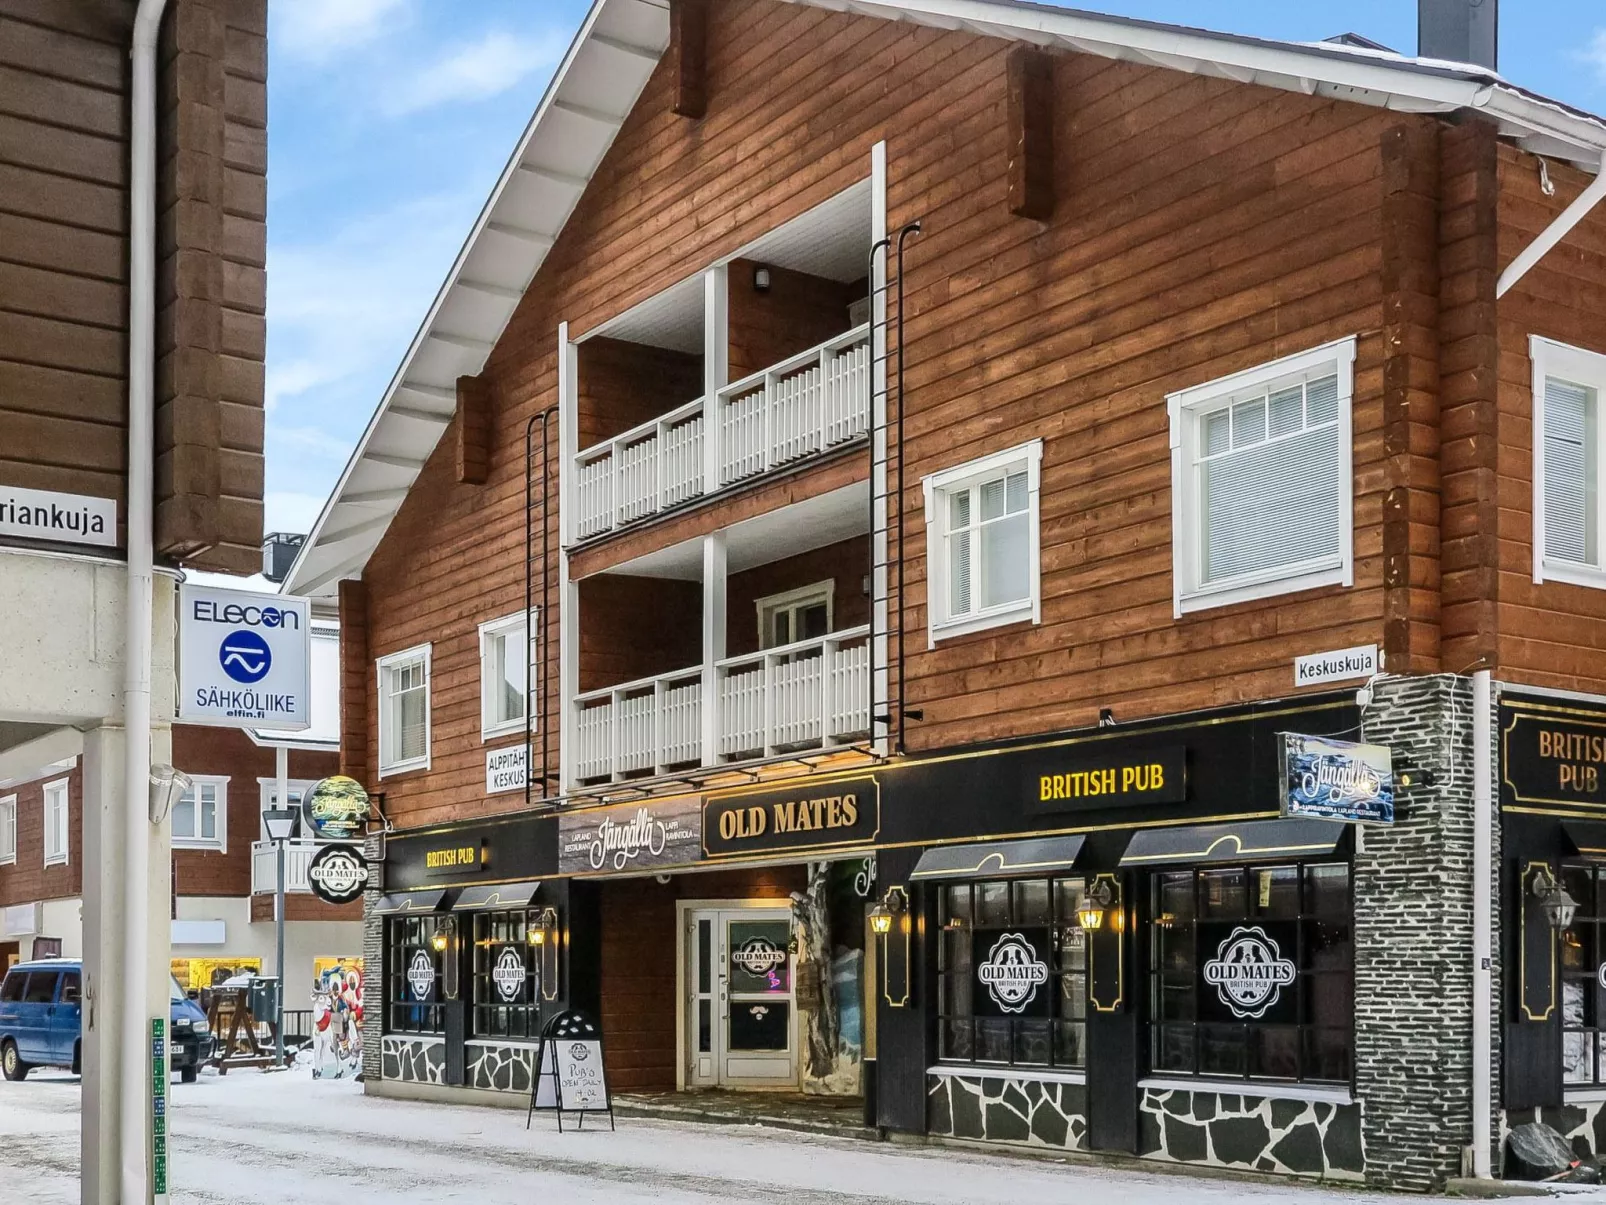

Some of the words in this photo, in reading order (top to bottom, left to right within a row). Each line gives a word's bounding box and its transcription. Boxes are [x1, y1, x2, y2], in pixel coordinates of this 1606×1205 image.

[1299, 653, 1372, 679] Keskuskuja
[196, 685, 295, 713] SÄHKÖLIIKE
[226, 709, 266, 719] elfin.fi
[488, 749, 527, 772] ALPPITÄH
[493, 769, 525, 788] KESKUS
[1039, 768, 1116, 801] BRITISH
[1122, 763, 1164, 792] PUB
[1559, 763, 1598, 792] PUB
[719, 806, 767, 840] OLD
[773, 794, 858, 834] MATES
[589, 807, 666, 870] Jängällä
[426, 849, 457, 868] BRITISH
[458, 847, 474, 865] PUB
[314, 869, 334, 878] OLD
[335, 869, 365, 878] MATES
[734, 953, 753, 961] OLD
[754, 953, 783, 961] MATES
[982, 966, 1005, 980] OLD
[1006, 966, 1044, 980] MATES
[1208, 965, 1238, 979] OLD
[1241, 965, 1290, 979] MATES
